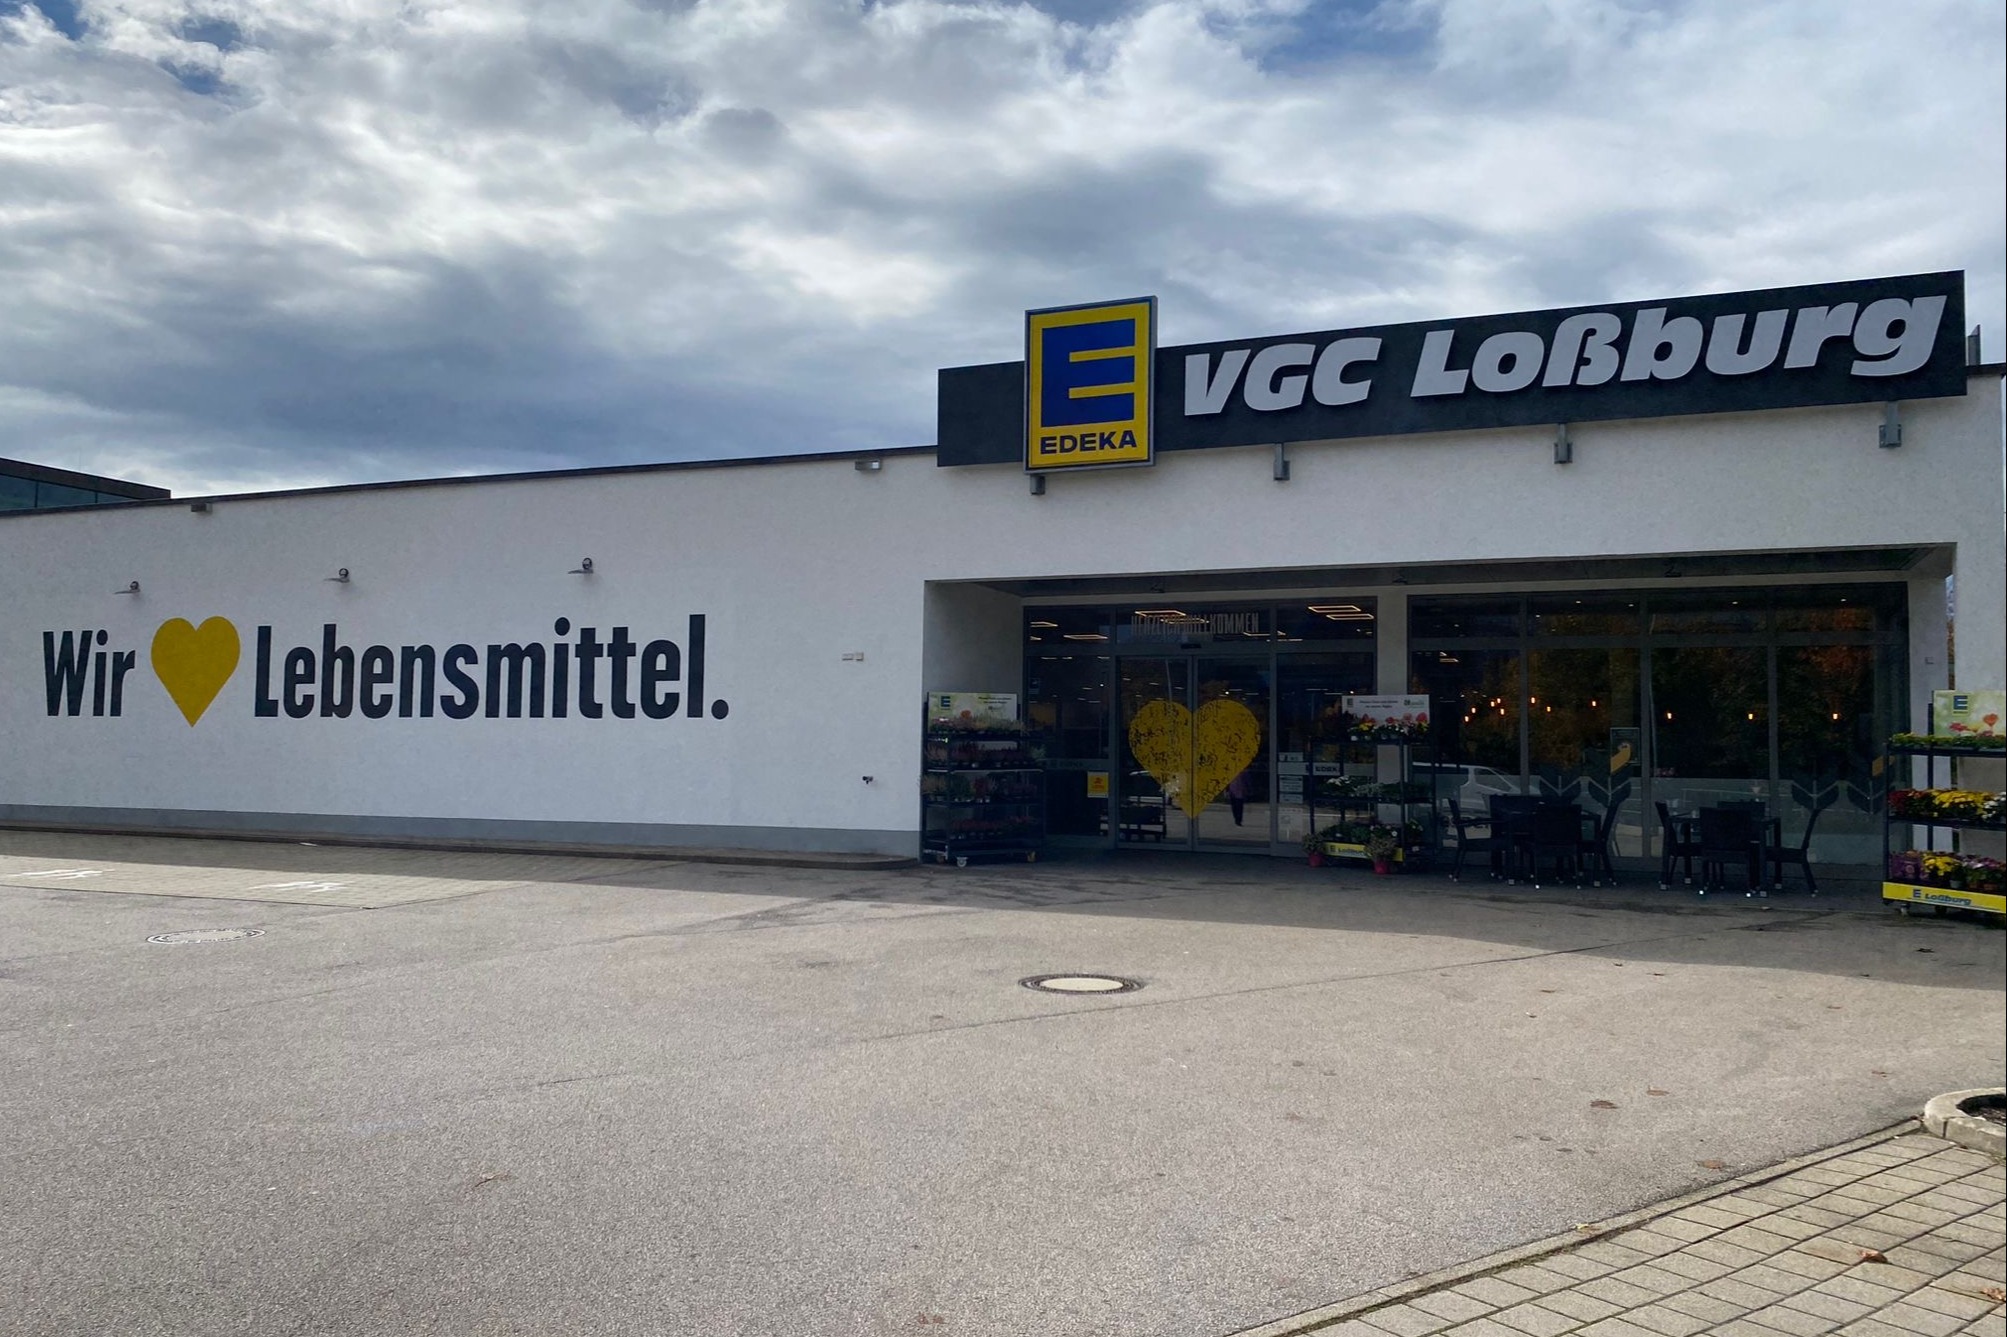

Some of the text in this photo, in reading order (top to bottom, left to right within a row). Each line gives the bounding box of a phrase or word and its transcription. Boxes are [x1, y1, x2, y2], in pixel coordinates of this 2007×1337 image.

[1041, 320, 1136, 428] E
[1185, 295, 1947, 416] VGC Loßburg
[1040, 430, 1137, 454] EDEKA
[43, 613, 730, 720] Wir Lebensmittel.
[1183, 611, 1260, 636] WILLKOMMEN
